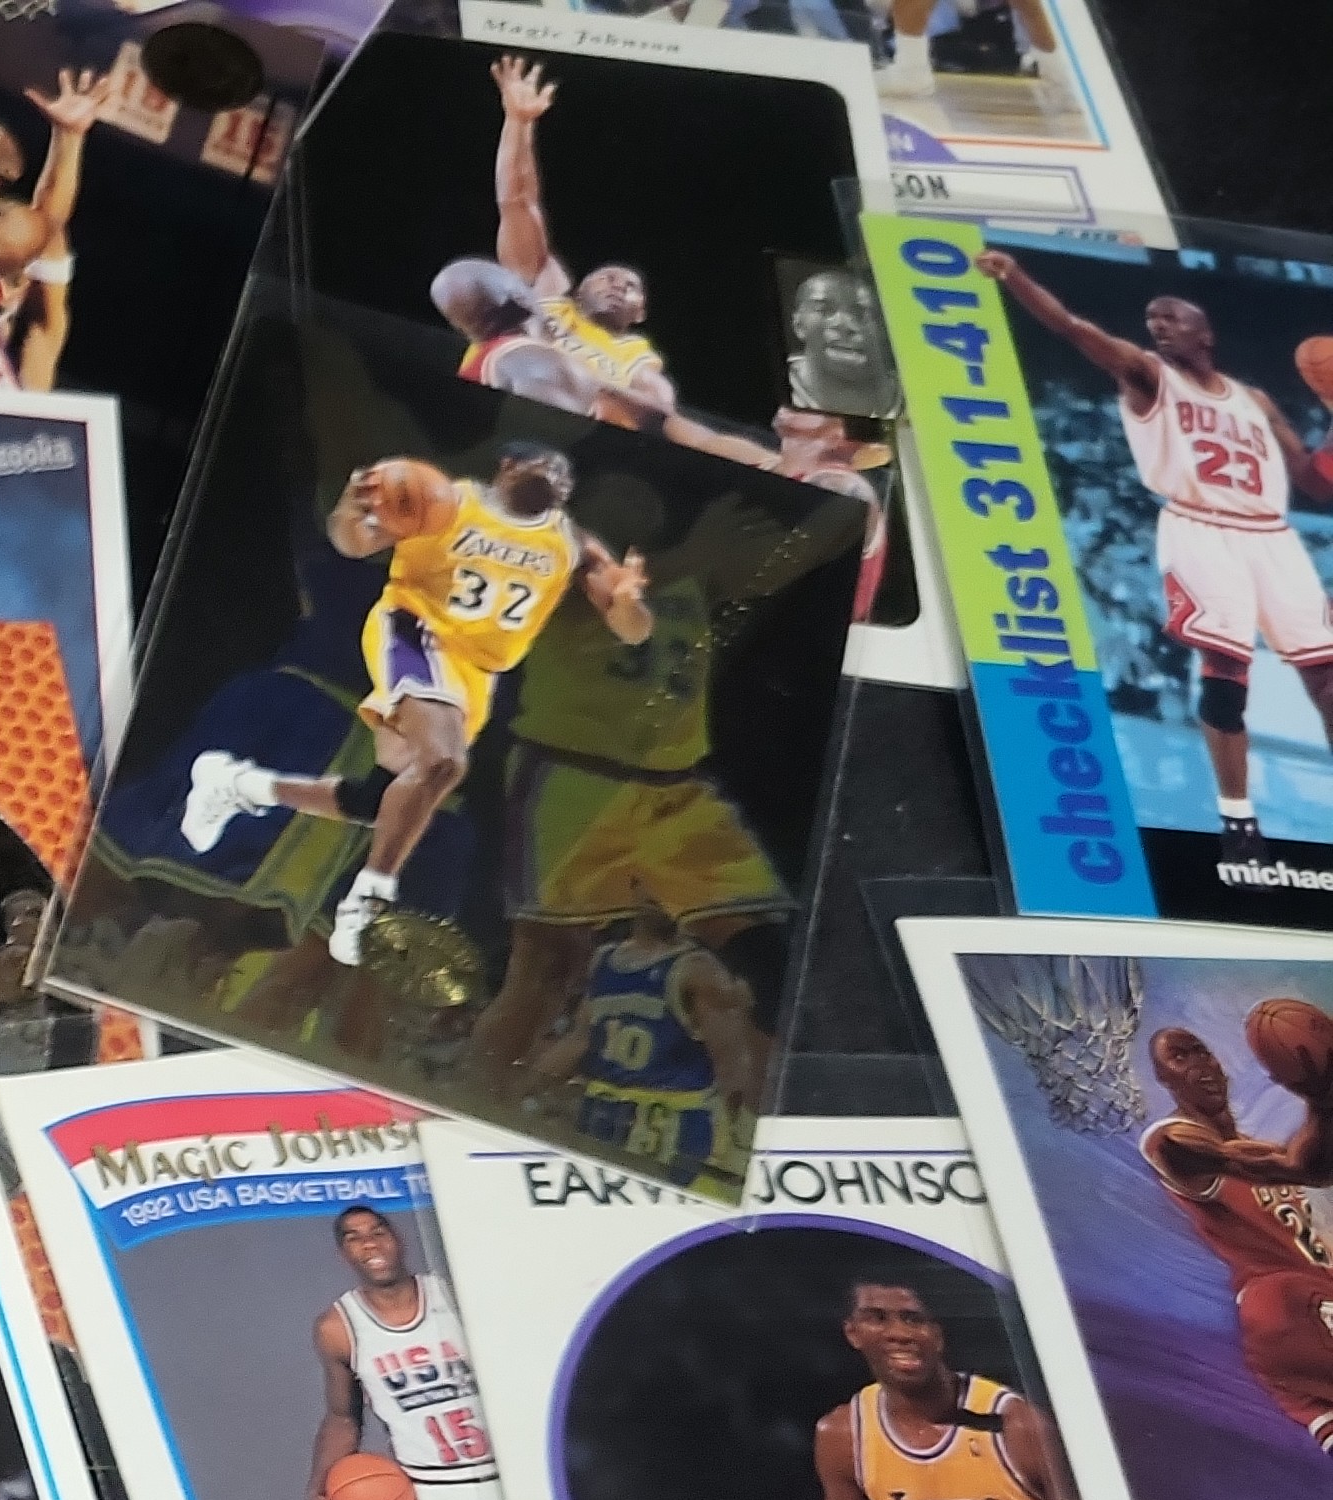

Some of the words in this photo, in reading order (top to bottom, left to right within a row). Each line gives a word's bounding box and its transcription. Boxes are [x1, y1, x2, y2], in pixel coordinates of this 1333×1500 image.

[900, 238, 1037, 522] 311-410
[1192, 439, 1263, 496] 23
[447, 566, 541, 631] 32
[986, 544, 1126, 885] checklist
[120, 1195, 177, 1228] 1992
[176, 1186, 235, 1215] USA
[235, 1176, 404, 1208] BASKETBALL
[425, 1408, 490, 1464] 15
